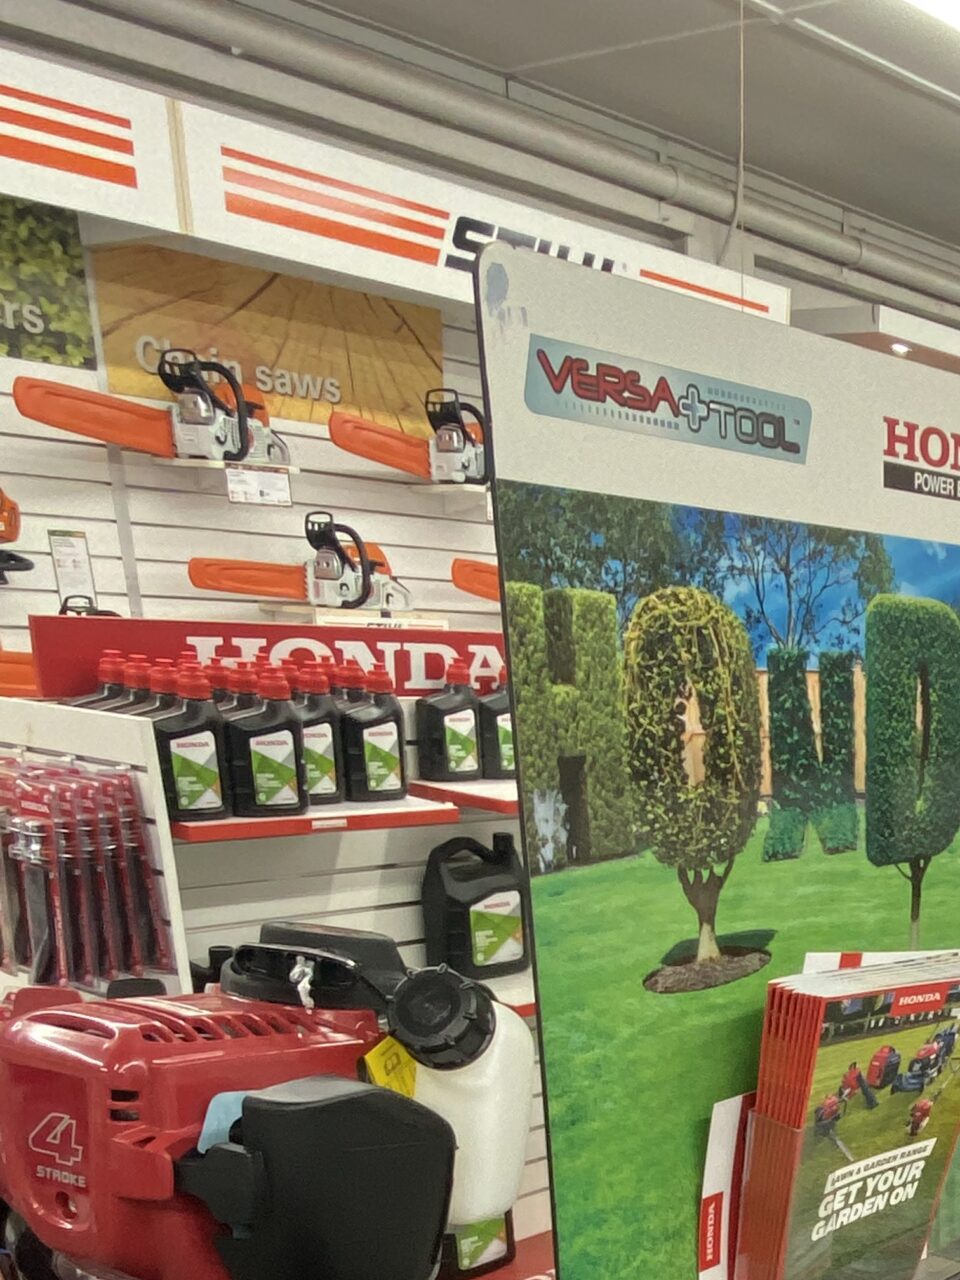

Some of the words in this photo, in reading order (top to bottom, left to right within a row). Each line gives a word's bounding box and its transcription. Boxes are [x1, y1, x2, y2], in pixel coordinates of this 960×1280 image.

[255, 363, 341, 403] saws
[914, 472, 955, 496] POWER
[175, 740, 211, 749] HONDA
[253, 738, 289, 748] HONDA
[899, 992, 941, 1006] HONDA
[28, 1112, 83, 1166] 4
[864, 1154, 898, 1172] GARDEN
[900, 1144, 930, 1160] RANGE
[36, 1165, 87, 1188] STROKE
[818, 1181, 863, 1218] GET
[865, 1160, 926, 1197] YOUR
[811, 1192, 889, 1241] GARDEN
[889, 1181, 919, 1205] ON
[706, 1201, 716, 1262] HONDA
